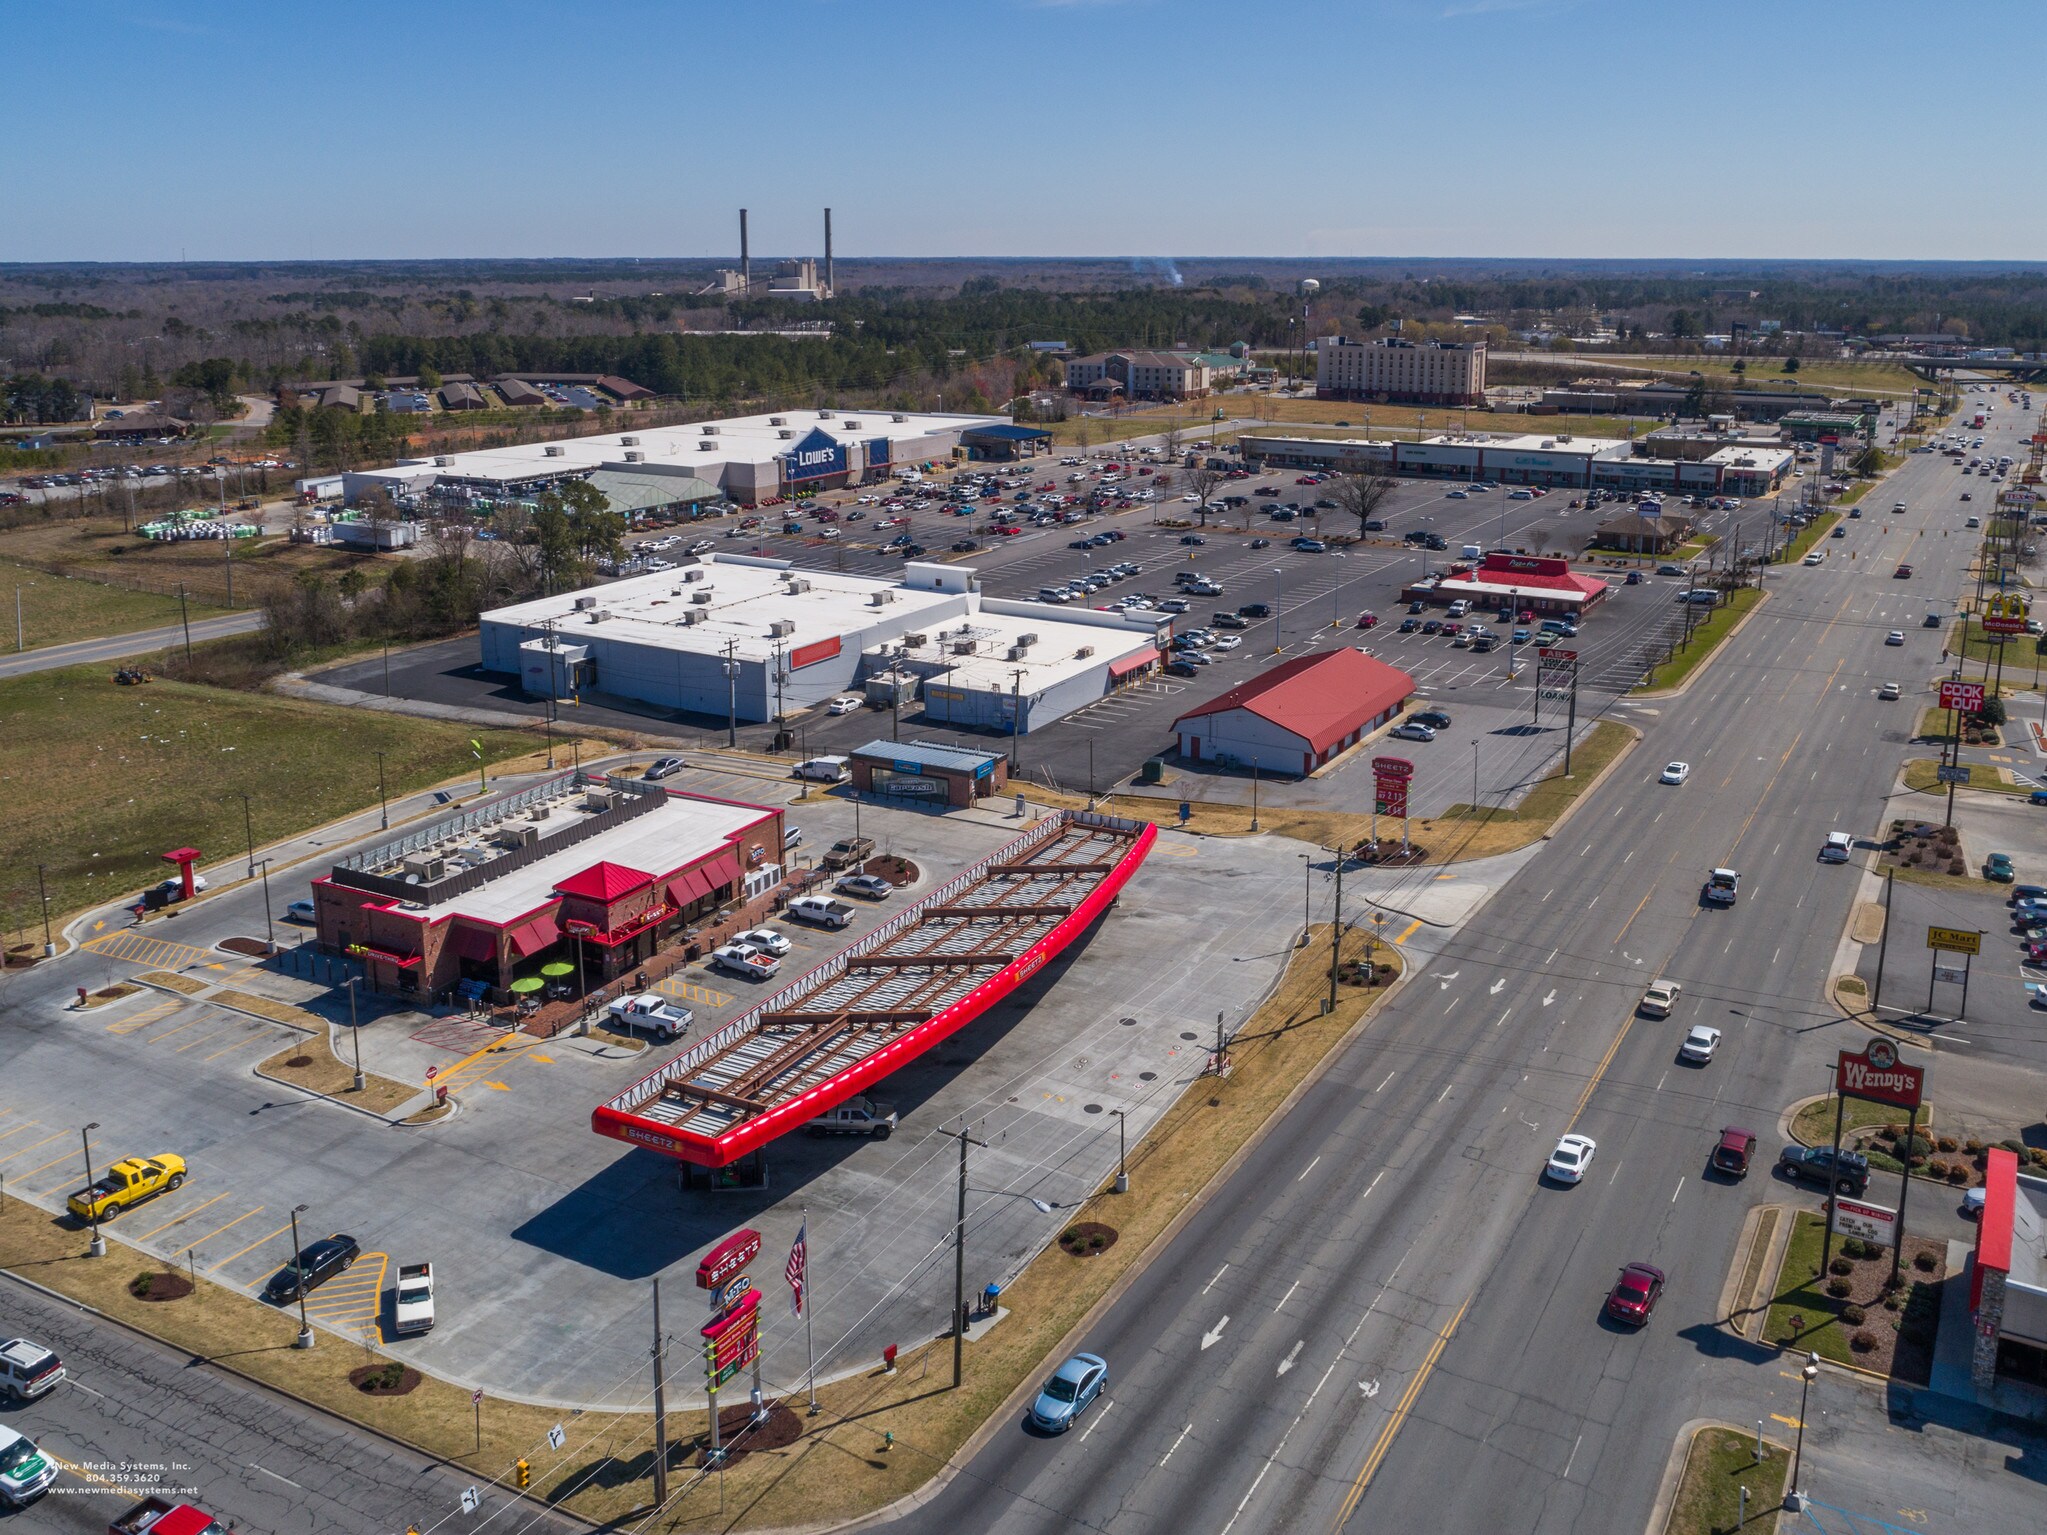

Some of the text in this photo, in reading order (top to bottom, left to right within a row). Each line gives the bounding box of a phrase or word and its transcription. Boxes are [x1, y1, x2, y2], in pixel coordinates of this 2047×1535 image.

[799, 447, 835, 467] LOWE'S
[1508, 560, 1526, 568] Pizza
[1984, 621, 2024, 629] McDonald's
[1546, 650, 1569, 659] ABC
[1942, 683, 1982, 699] COOK
[1952, 697, 1982, 712] OUT
[1375, 762, 1409, 772] SHEETZ
[1931, 930, 1977, 943] JC Mart
[1019, 955, 1042, 977] SHEETZ
[628, 1129, 673, 1148] SHEETZ
[1839, 1216, 1873, 1229] CATCH OUR
[711, 1240, 758, 1283] SHEETZ
